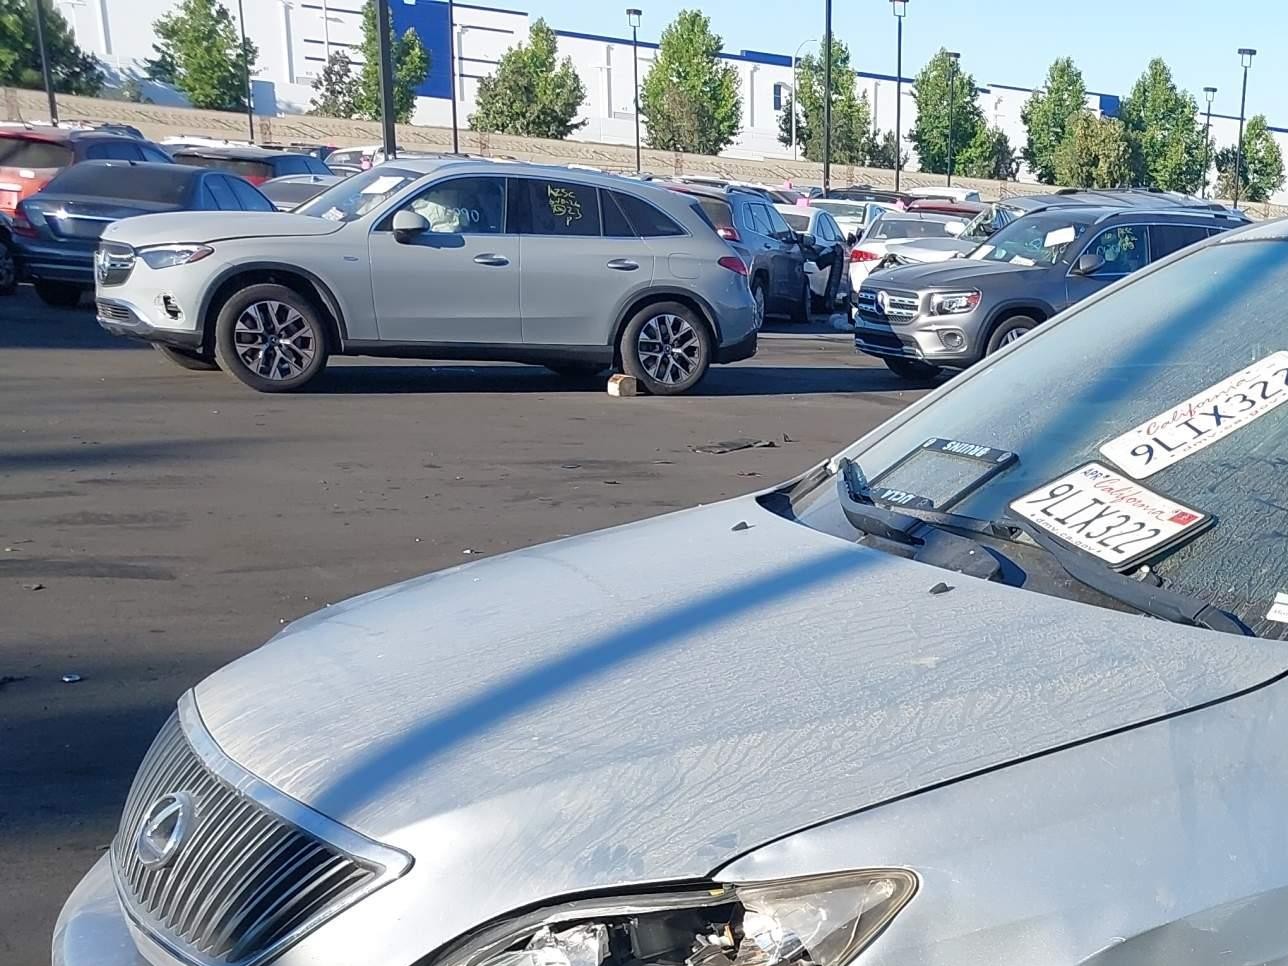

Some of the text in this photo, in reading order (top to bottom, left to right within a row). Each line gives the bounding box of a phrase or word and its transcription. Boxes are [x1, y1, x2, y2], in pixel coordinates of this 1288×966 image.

[1146, 374, 1261, 437] California
[942, 440, 992, 458] BRUINS
[881, 488, 917, 504] UCLA
[1094, 478, 1168, 522] California
[1026, 483, 1161, 554] 9LIX322
